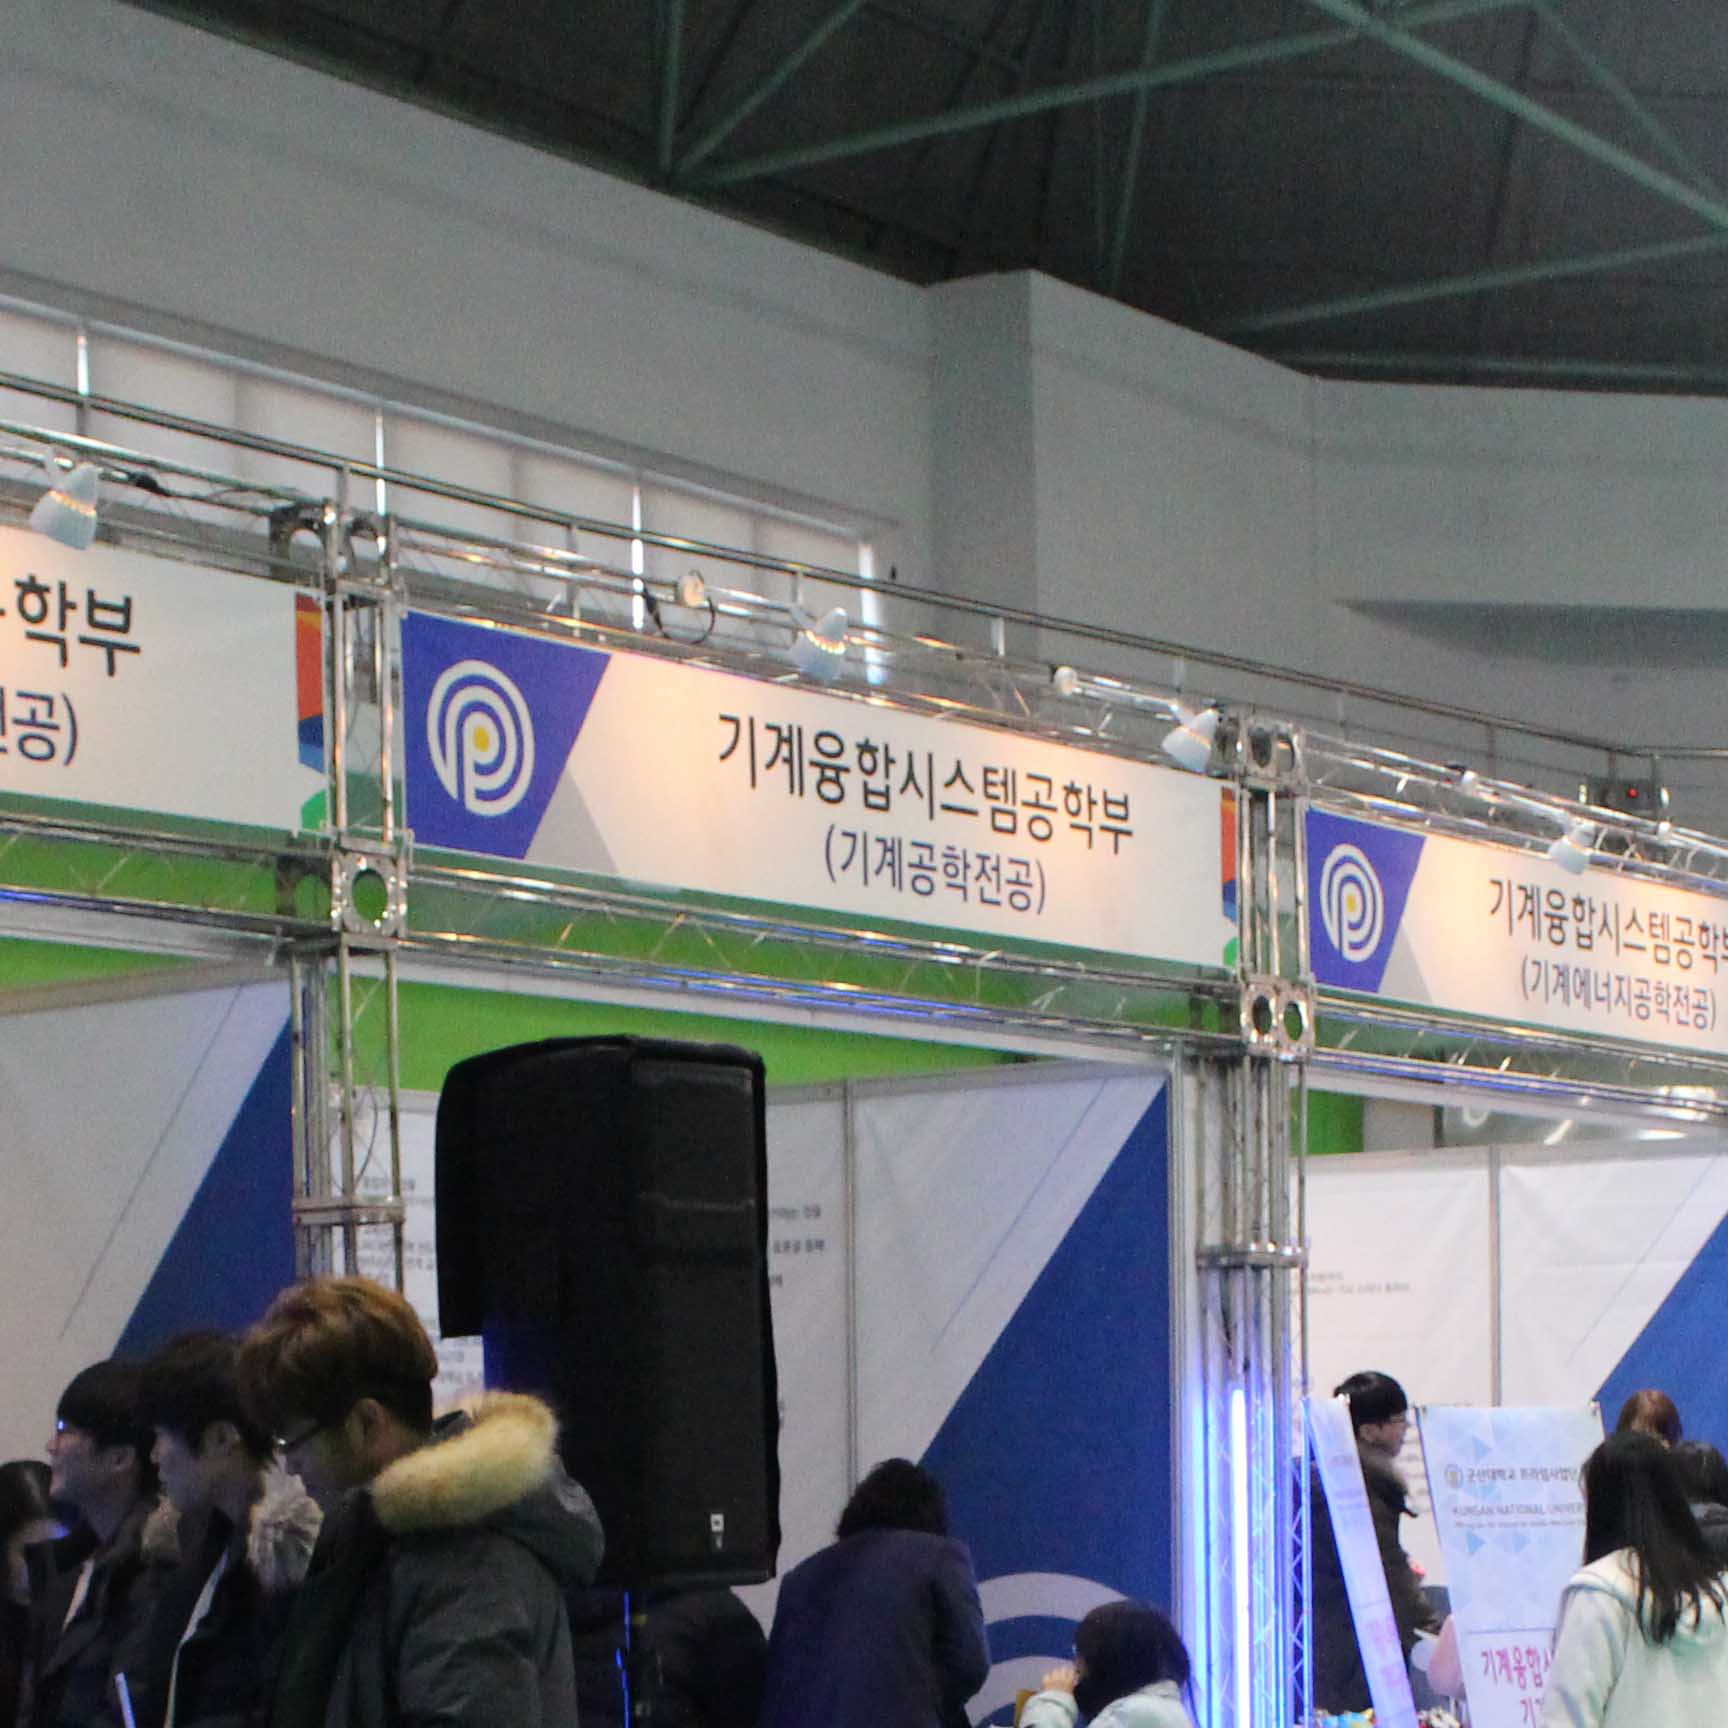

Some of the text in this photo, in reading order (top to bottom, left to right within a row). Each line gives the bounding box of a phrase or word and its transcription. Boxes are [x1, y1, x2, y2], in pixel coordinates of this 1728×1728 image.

[717, 711, 1134, 856] 기계융합시스템공학부
[825, 823, 1046, 916] (기계공학전공)
[1522, 953, 1717, 1032] (기계에너지공학전공)
